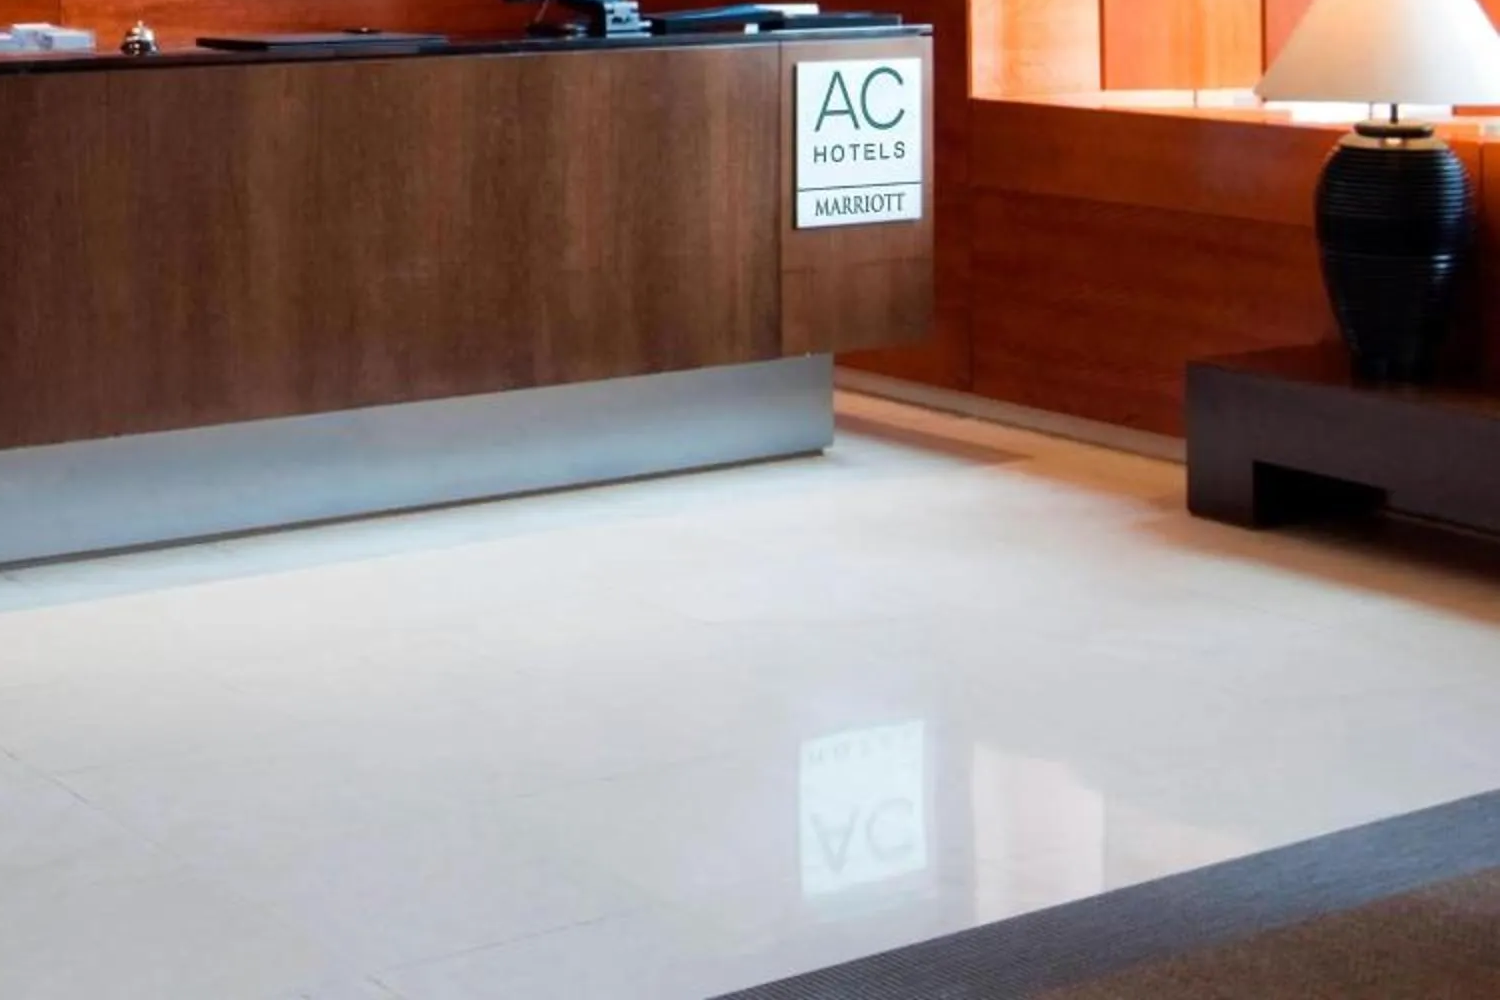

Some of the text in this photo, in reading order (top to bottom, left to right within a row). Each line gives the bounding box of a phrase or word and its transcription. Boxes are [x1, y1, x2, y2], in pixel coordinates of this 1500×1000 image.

[814, 66, 905, 132] AC
[813, 141, 906, 163] HOTELS
[815, 193, 906, 217] MARRIOTT
